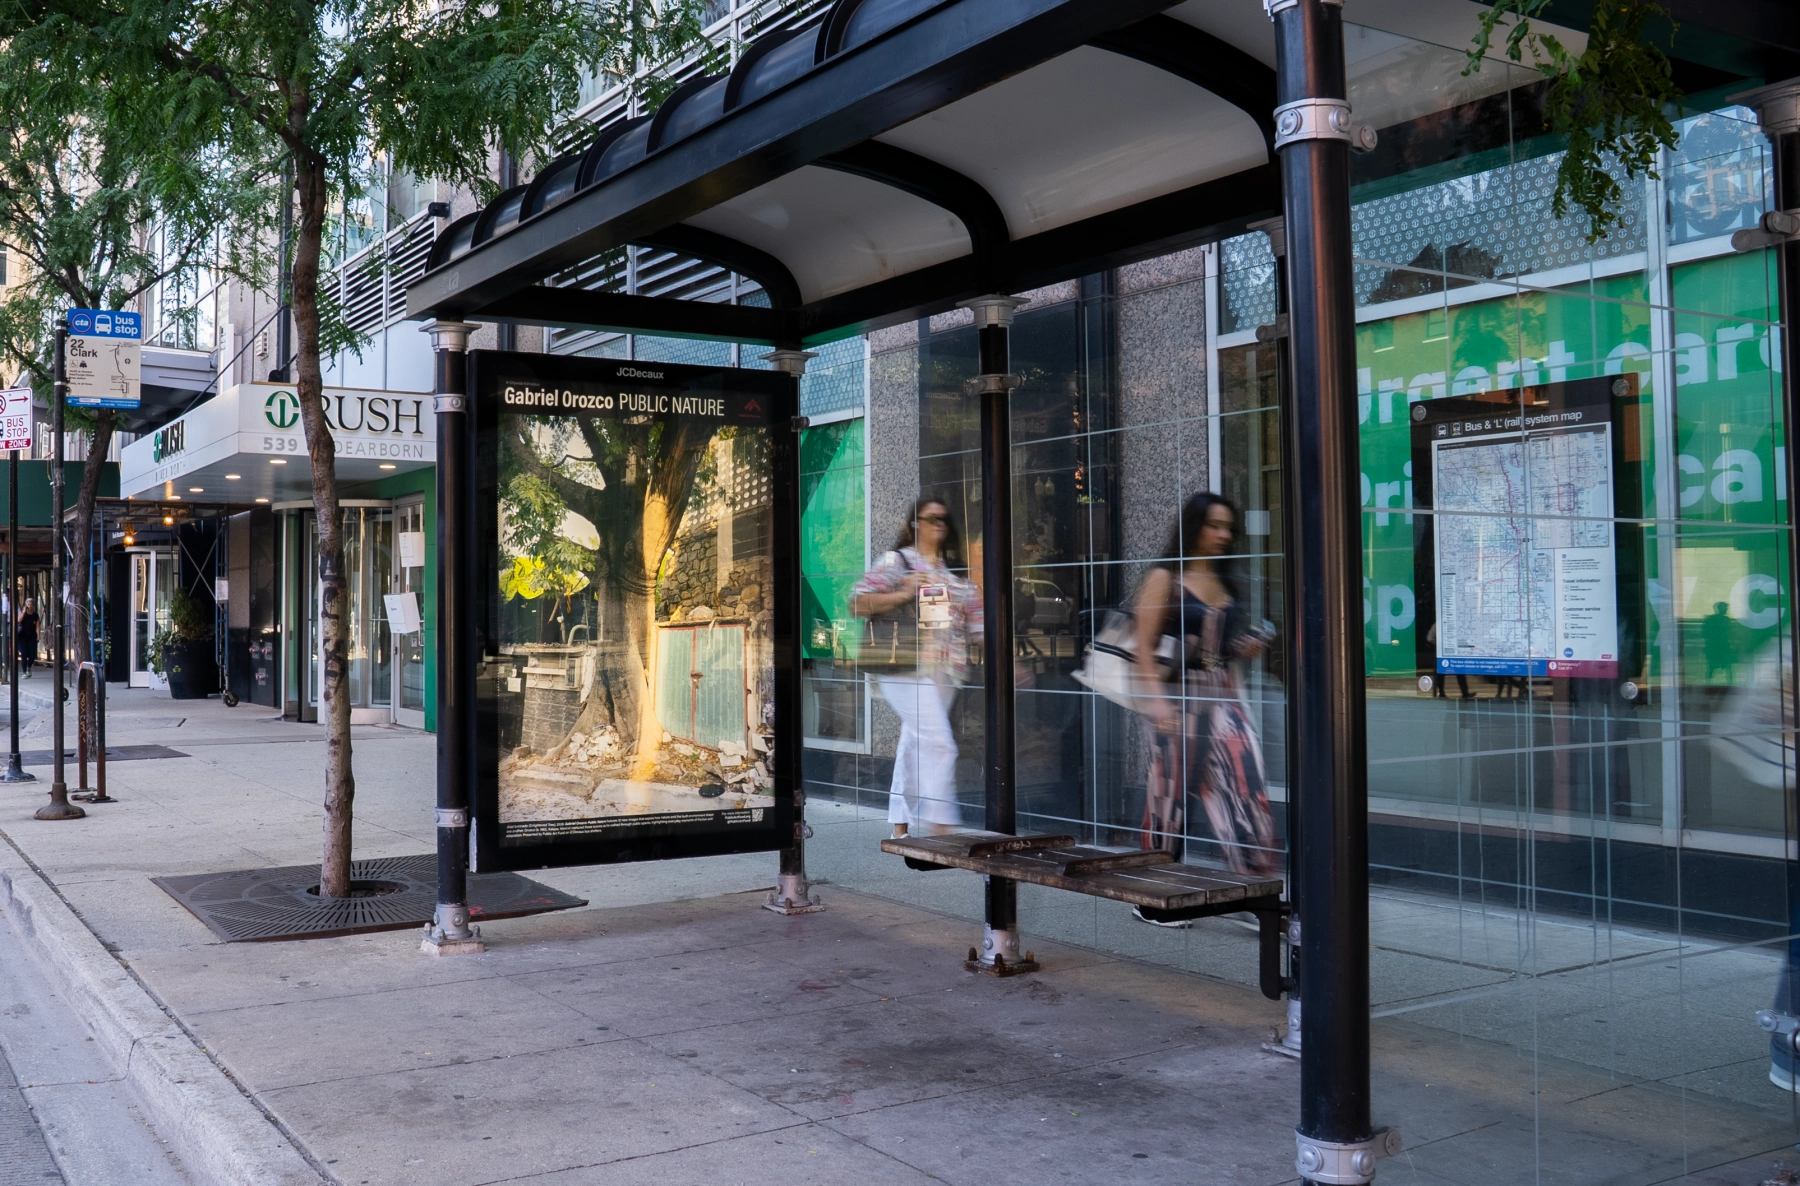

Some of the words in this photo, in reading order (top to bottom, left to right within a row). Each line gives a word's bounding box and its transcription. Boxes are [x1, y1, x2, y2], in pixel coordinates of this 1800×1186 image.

[443, 272, 459, 293] ta
[115, 315, 134, 325] bus
[115, 325, 138, 336] stop
[70, 339, 84, 348] 22
[70, 348, 97, 357] Clark
[616, 367, 664, 379] JCDecaux
[504, 386, 559, 407] Gabriel
[562, 390, 613, 409] Orozco
[619, 392, 668, 413] PUBLIC
[672, 396, 724, 416] NATURE
[321, 395, 424, 434] RUSH
[7, 418, 24, 427] BUS
[1465, 421, 1483, 432] Bus
[1484, 421, 1491, 430] &
[1504, 416, 1524, 429] (rail)
[1525, 415, 1559, 427] system
[1561, 411, 1582, 422] map
[7, 428, 28, 437] STOP
[9, 439, 27, 448] ZONE
[161, 420, 185, 459] RUSH
[263, 437, 298, 452] 539
[335, 441, 423, 458] DEARBORN
